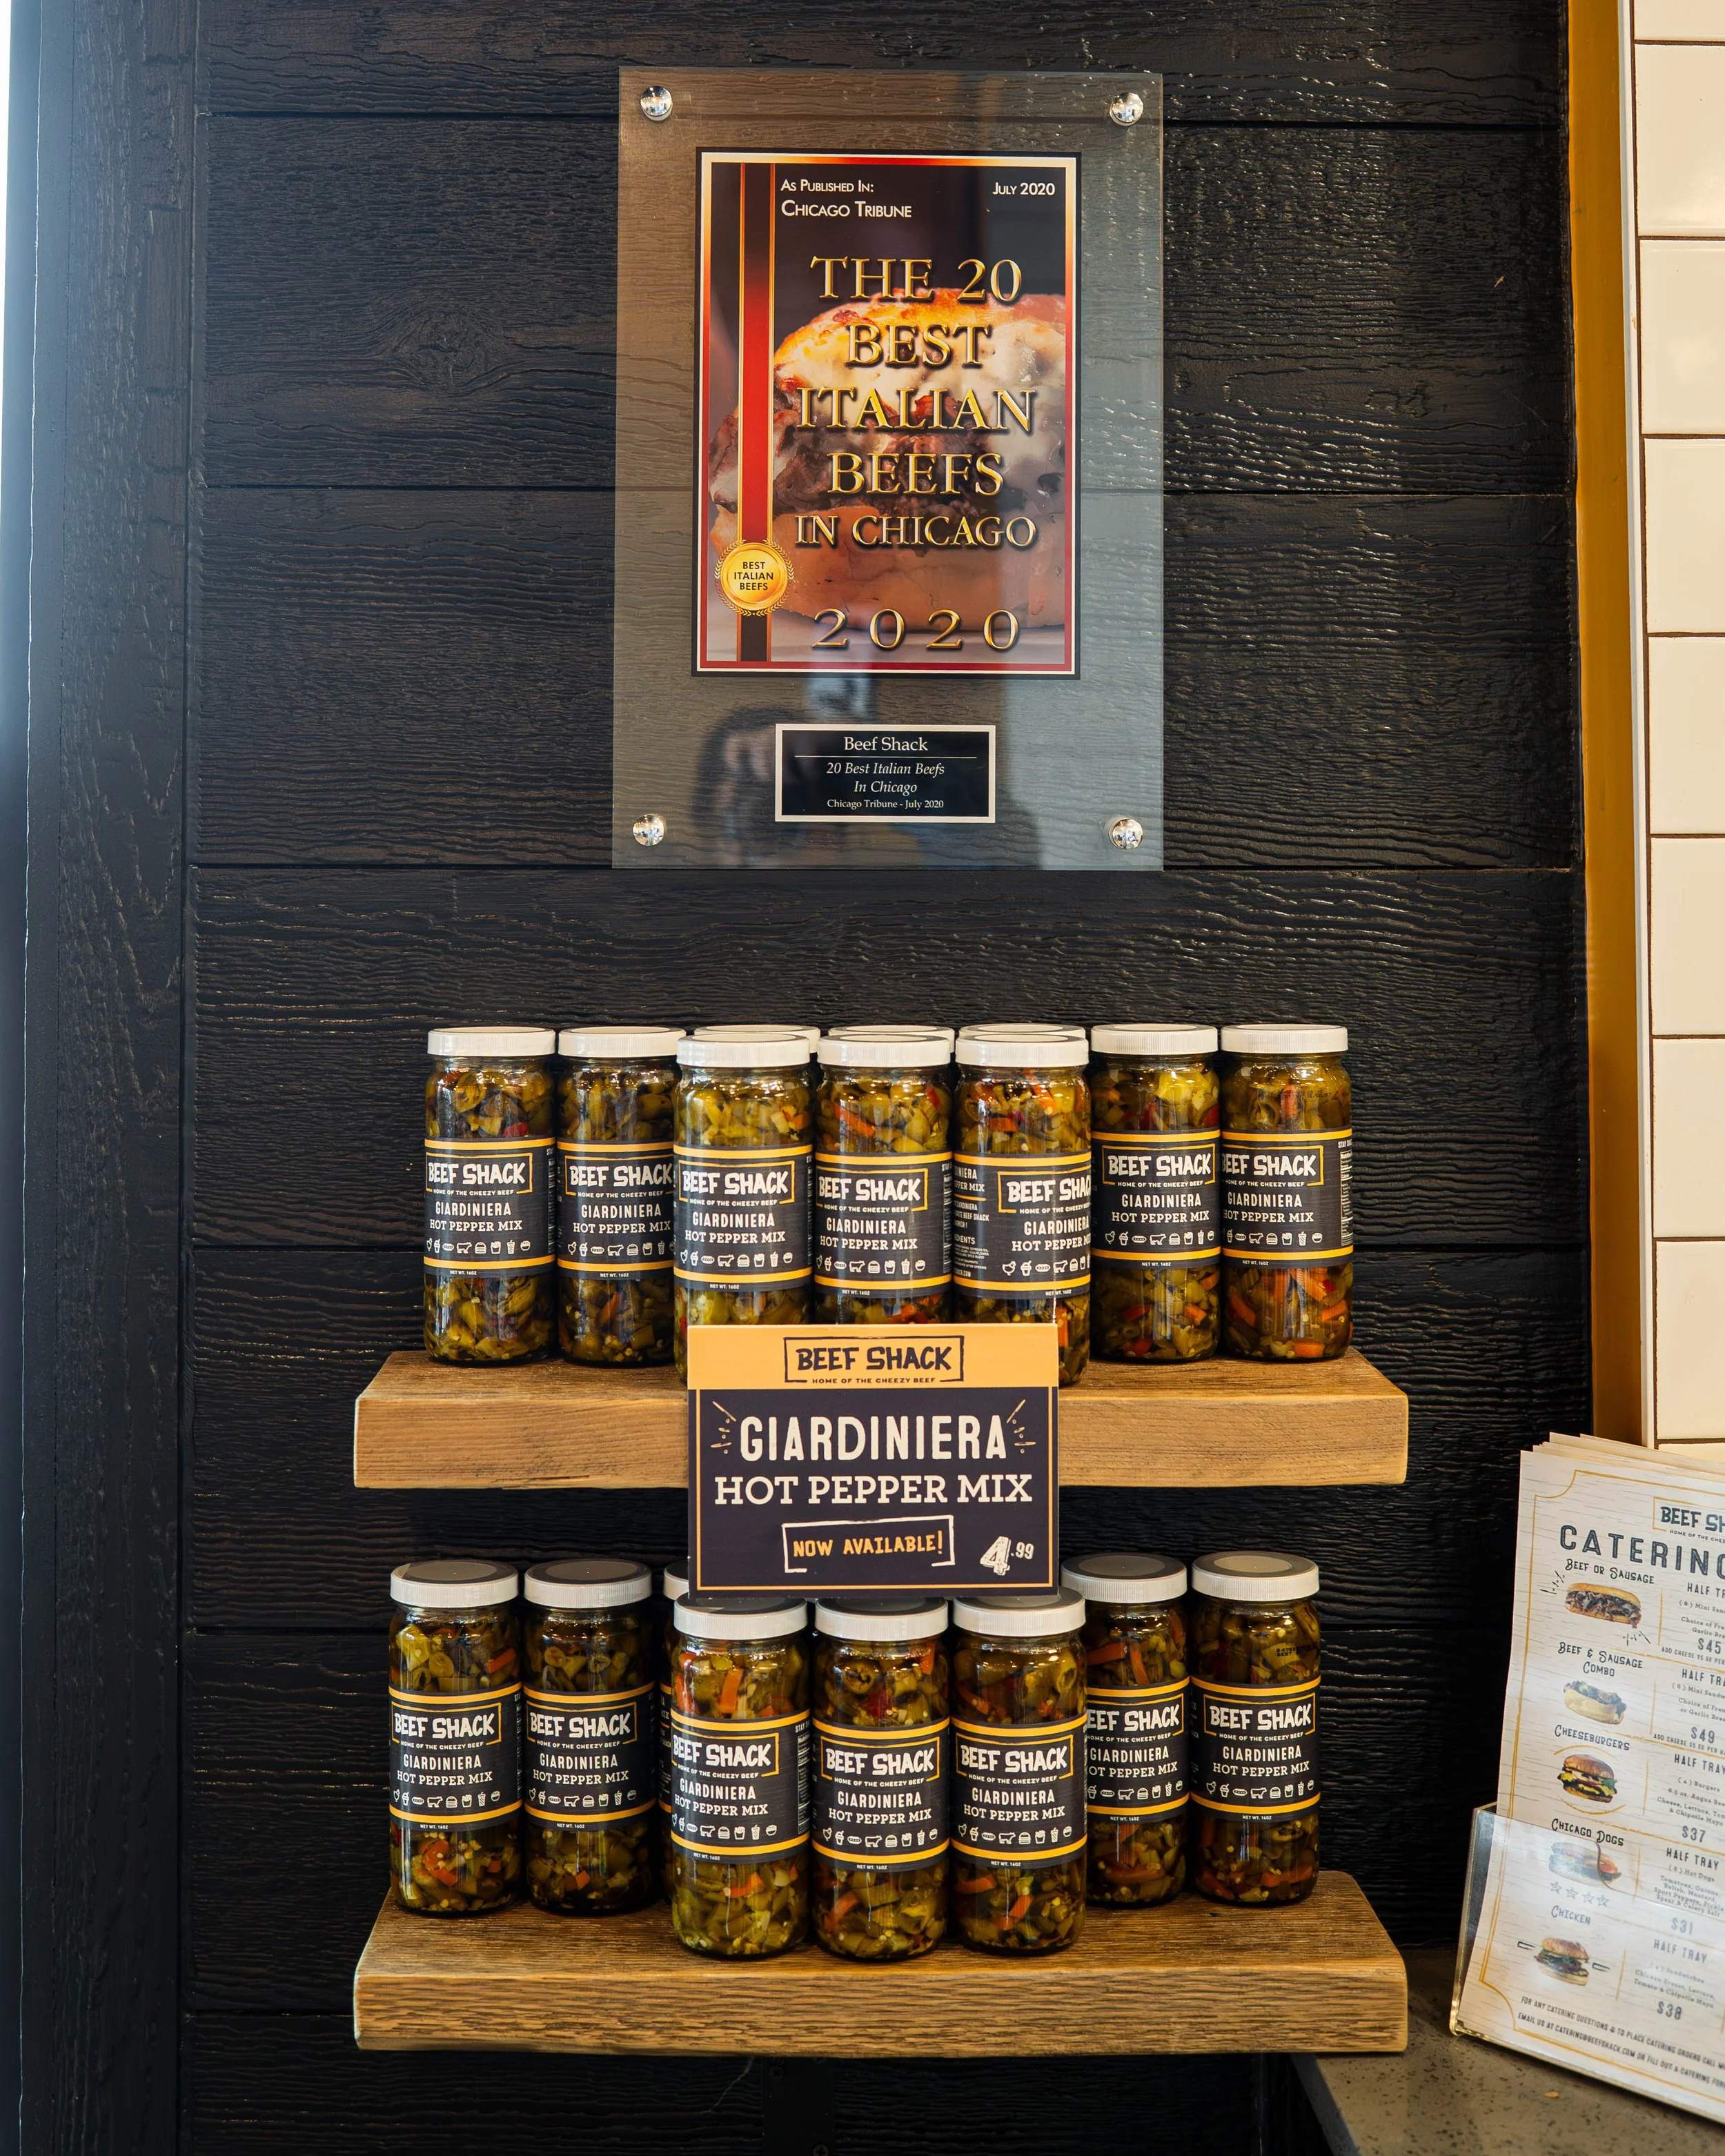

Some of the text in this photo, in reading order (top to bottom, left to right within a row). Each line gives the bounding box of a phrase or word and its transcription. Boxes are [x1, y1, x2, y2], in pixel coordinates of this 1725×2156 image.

[1021, 183, 1055, 195] 2020
[810, 256, 1022, 301] THE 20
[846, 324, 991, 366] BEST
[796, 386, 1036, 433] ITALIAN
[827, 453, 1005, 496] BEEFS
[795, 515, 1036, 547] IN CHICAGO
[733, 572, 773, 580] ITALIAN
[742, 562, 765, 570] BEST
[739, 582, 768, 591] BEEFS
[844, 737, 928, 751] Beef Shack
[827, 762, 945, 778] 20 Best Italian Beefs
[854, 781, 917, 795] In Chicago
[827, 800, 944, 810] Chicago Tribune July 2020
[428, 1162, 526, 1185] BEEF SHACK
[570, 1163, 672, 1187] BEEF SHACK
[1107, 1153, 1212, 1176] BEEF SHACK
[1222, 1154, 1317, 1176] BEEF SHACK
[682, 1171, 788, 1195] BEEF SHACK
[818, 1176, 920, 1201] BEEF SHACK
[1007, 1177, 1091, 1203] BEEF SHAC
[435, 1201, 511, 1216] GIARDINIERA
[1121, 1193, 1201, 1208] GIARDINIERA
[430, 1219, 523, 1232] HOT PEPPER MIX
[1112, 1211, 1209, 1223] HOT PEPPER MIX
[796, 1346, 952, 1371] BEEF SHACK
[740, 1414, 1007, 1461] GIARDINIERA
[714, 1474, 1033, 1505] HOT PEPPER MIX
[1661, 1506, 1701, 1527] BEEF
[793, 1530, 943, 1558] NOW AVAILABLE!
[1687, 1583, 1710, 1595] HALF
[1682, 1616, 1703, 1625] Choice
[1675, 1650, 1695, 1659] CHEESE
[1682, 1668, 1704, 1681] HALF
[394, 1712, 495, 1739] BEEF SHACK
[530, 1712, 631, 1739] BEEF SHACK
[1087, 1703, 1180, 1732] EEF SHACK
[1209, 1703, 1312, 1730] BEEF SHACK
[673, 1734, 771, 1768] BEEF SHACK
[1666, 1737, 1686, 1746] CHEESE
[825, 1748, 934, 1776] BEEF SHACK
[960, 1744, 1067, 1773] BEEF SHACK
[1674, 1754, 1697, 1768] HALF
[1694, 1781, 1720, 1792] Burgers
[838, 1790, 922, 1809] GIARDINIERA
[829, 1808, 931, 1824] HOT PEPPER MIX
[1666, 1848, 1719, 1870] HALF TRAY
[1654, 1939, 1707, 1964] HALF TRAY
[1521, 1997, 1532, 2006] FOR
[1533, 2001, 1546, 2009] ANY
[1547, 2004, 1575, 2020] CATERING
[1576, 2014, 1608, 2031] QUESTIONS
[1617, 2028, 1625, 2037] TO
[1626, 2031, 1645, 2044] PLACE
[1646, 2037, 1676, 2053] CATERING
[1677, 2048, 1702, 2062] ORDERS
[1702, 2056, 1716, 2068] CALL
[1517, 2012, 1535, 2024] EMAIL
[1537, 2018, 1545, 2026] US
[1546, 2021, 1555, 2030] AT
[1555, 2024, 1635, 2057] CATERING@BEEFSHACK.COM
[1637, 2053, 1646, 2061] OR
[1647, 2055, 1659, 2066] FILL
[1659, 2060, 1673, 2070] OUT
[1680, 2067, 1711, 2084] CATERING
